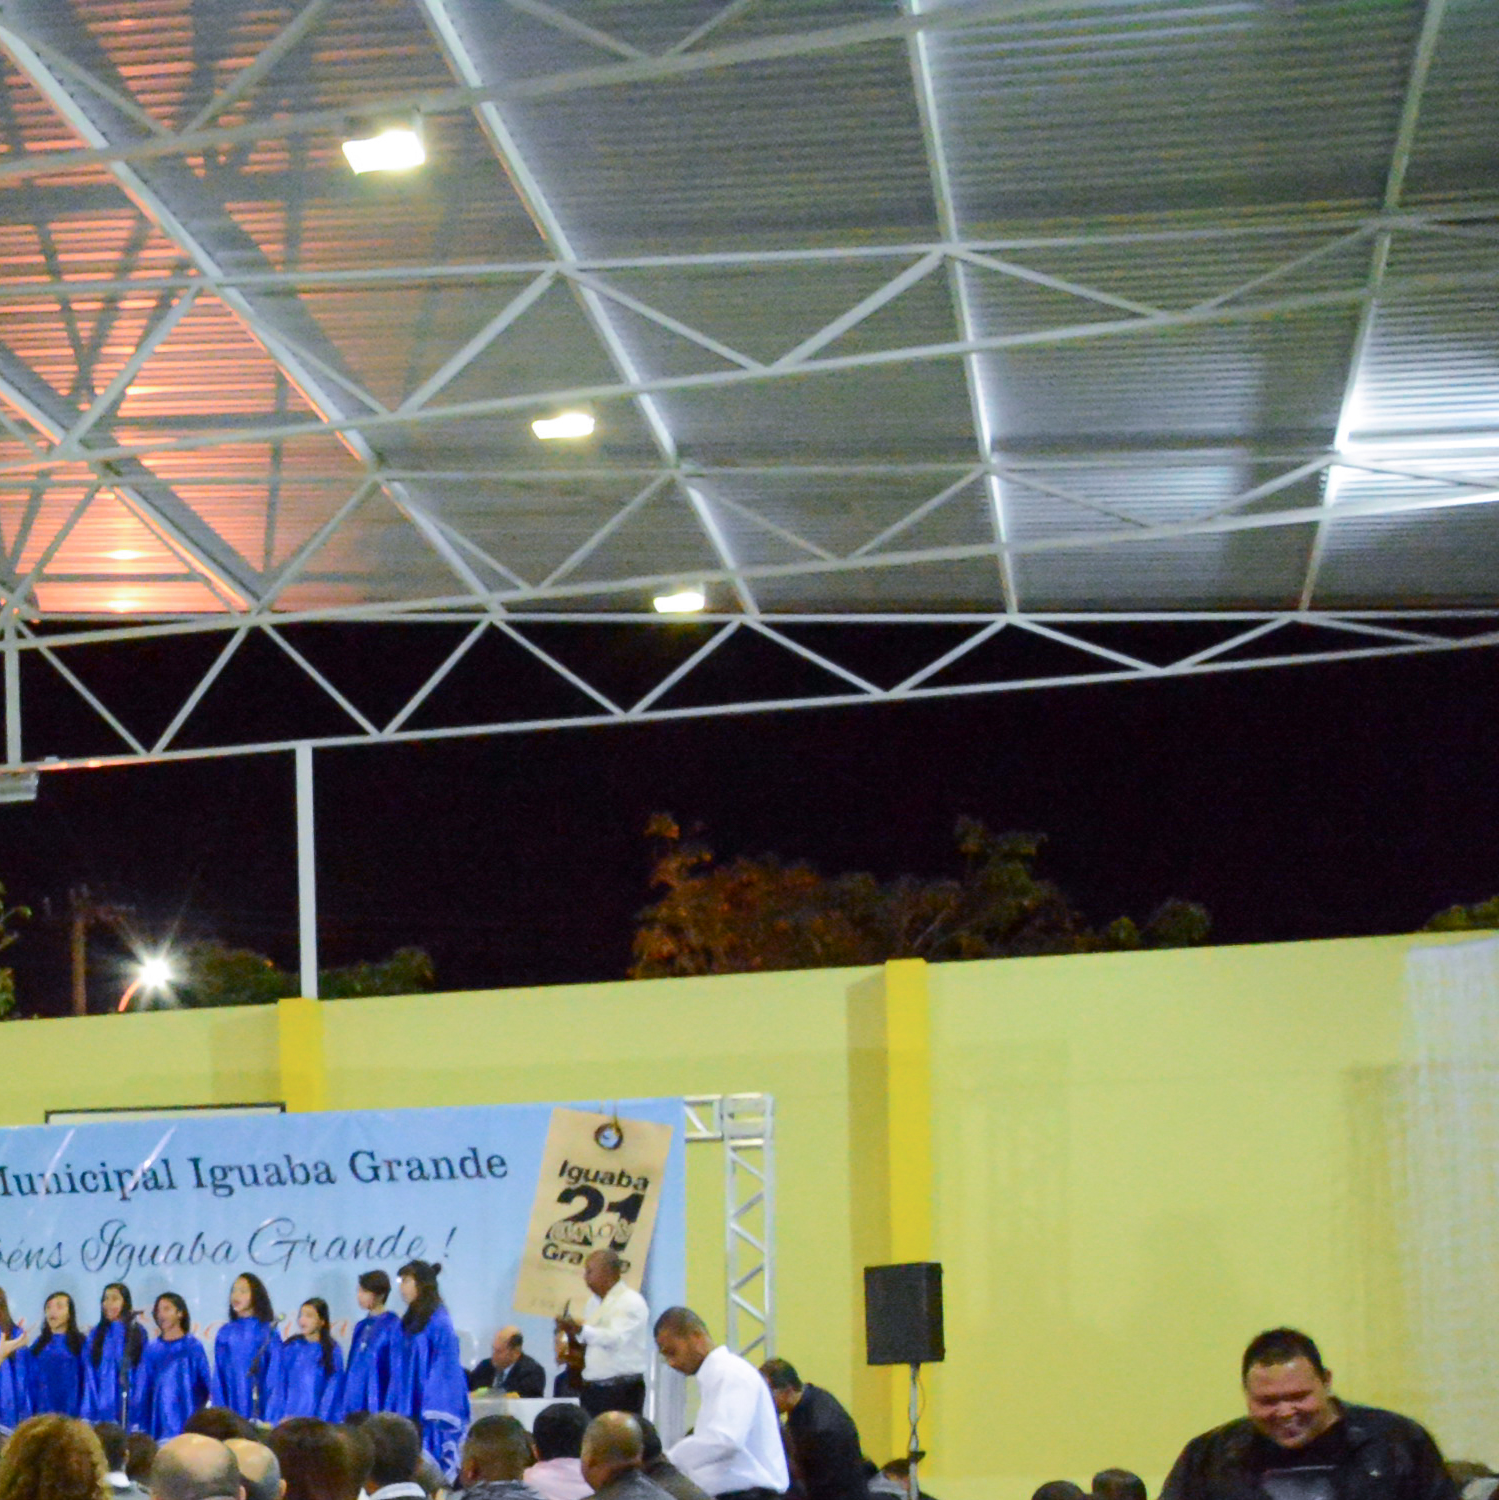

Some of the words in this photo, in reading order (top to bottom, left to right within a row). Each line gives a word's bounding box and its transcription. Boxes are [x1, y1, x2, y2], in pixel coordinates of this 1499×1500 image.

[187, 1154, 337, 1197] Iguaba
[348, 1147, 508, 1184] Grande
[557, 1159, 650, 1191] Iguaba
[545, 1184, 646, 1251] 21
[80, 1218, 238, 1282] Iguaba
[247, 1217, 428, 1272] Grande
[541, 1243, 631, 1274] Grae
